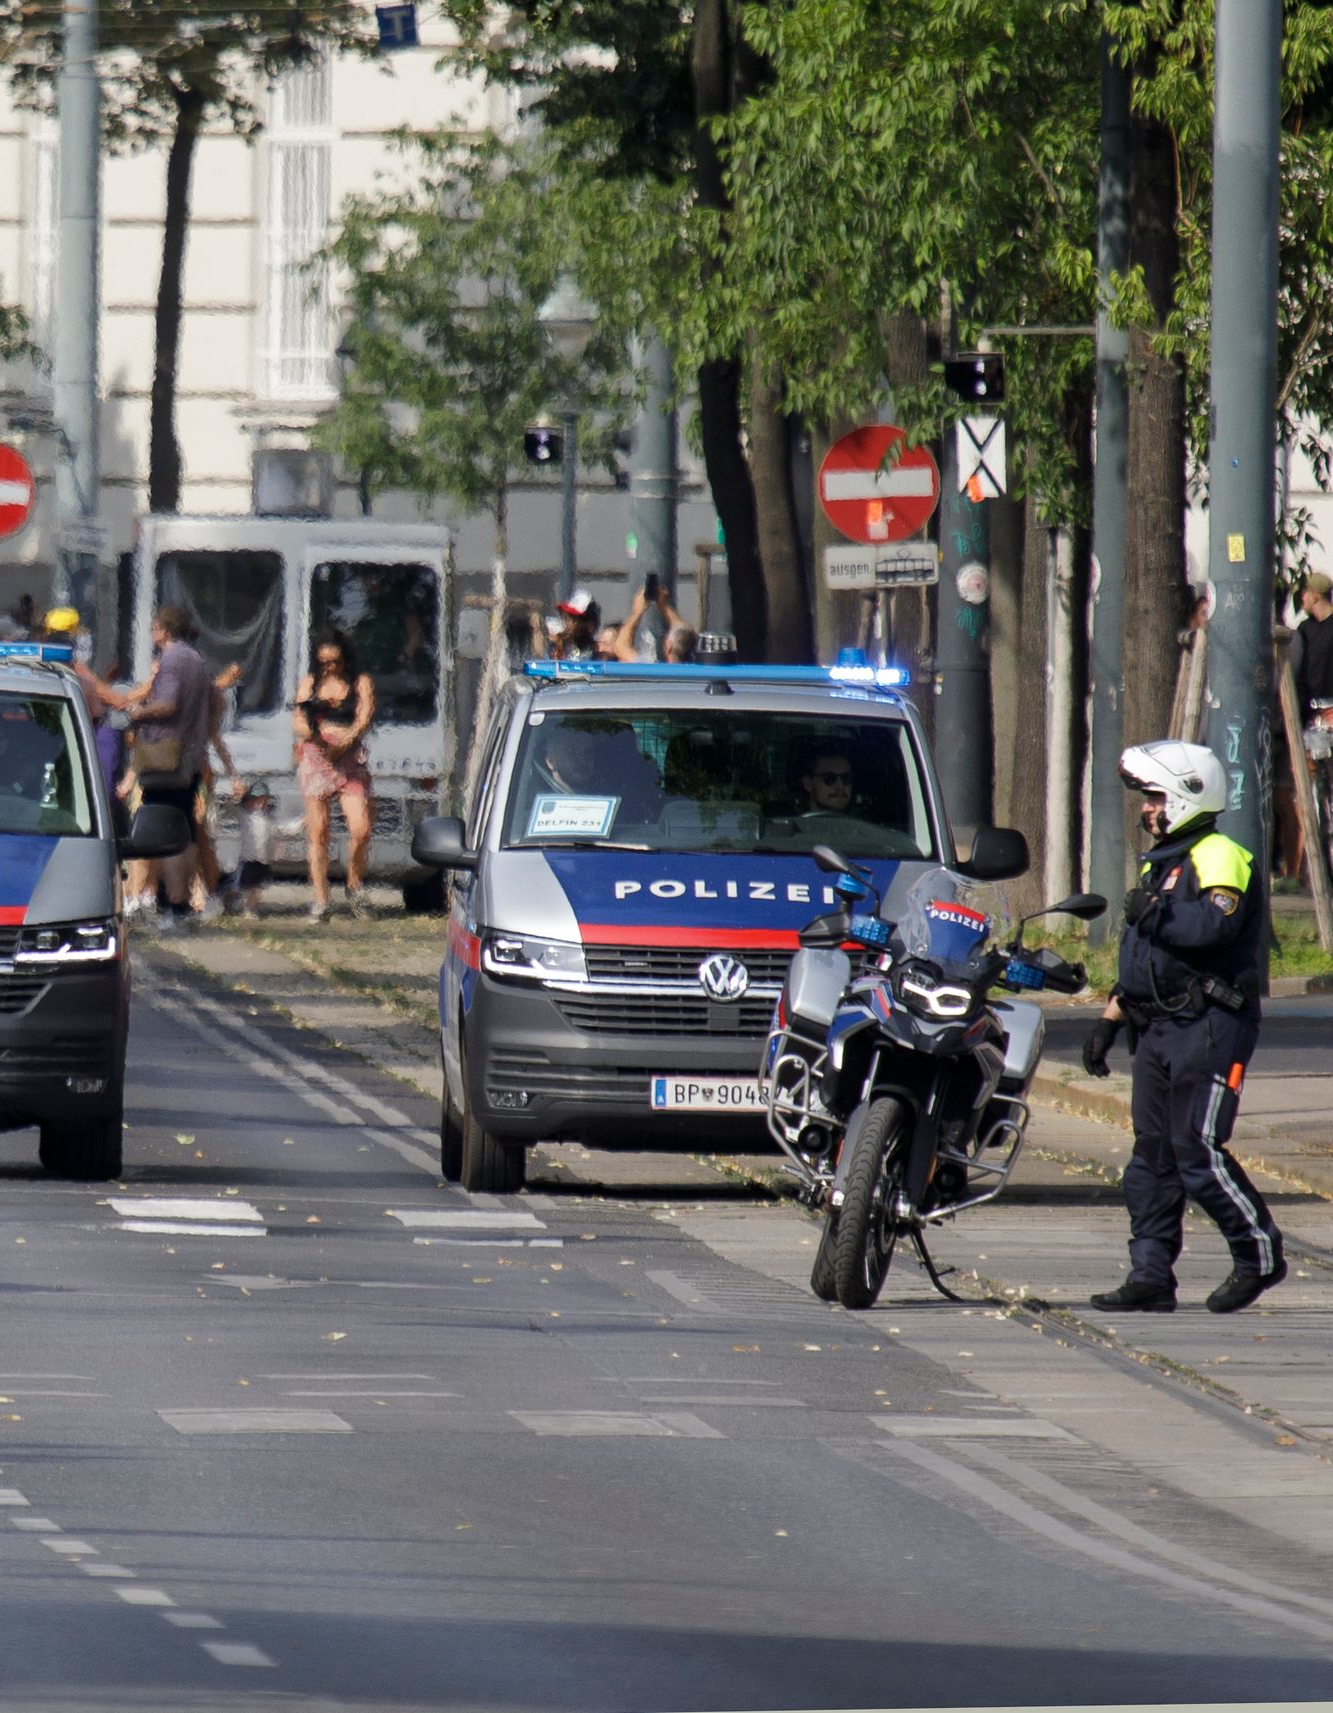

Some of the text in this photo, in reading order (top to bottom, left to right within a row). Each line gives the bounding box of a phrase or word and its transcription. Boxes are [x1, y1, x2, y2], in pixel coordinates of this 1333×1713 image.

[615, 880, 835, 904] POLIZEI
[930, 909, 985, 932] POLIZEI
[675, 1084, 700, 1104] BP
